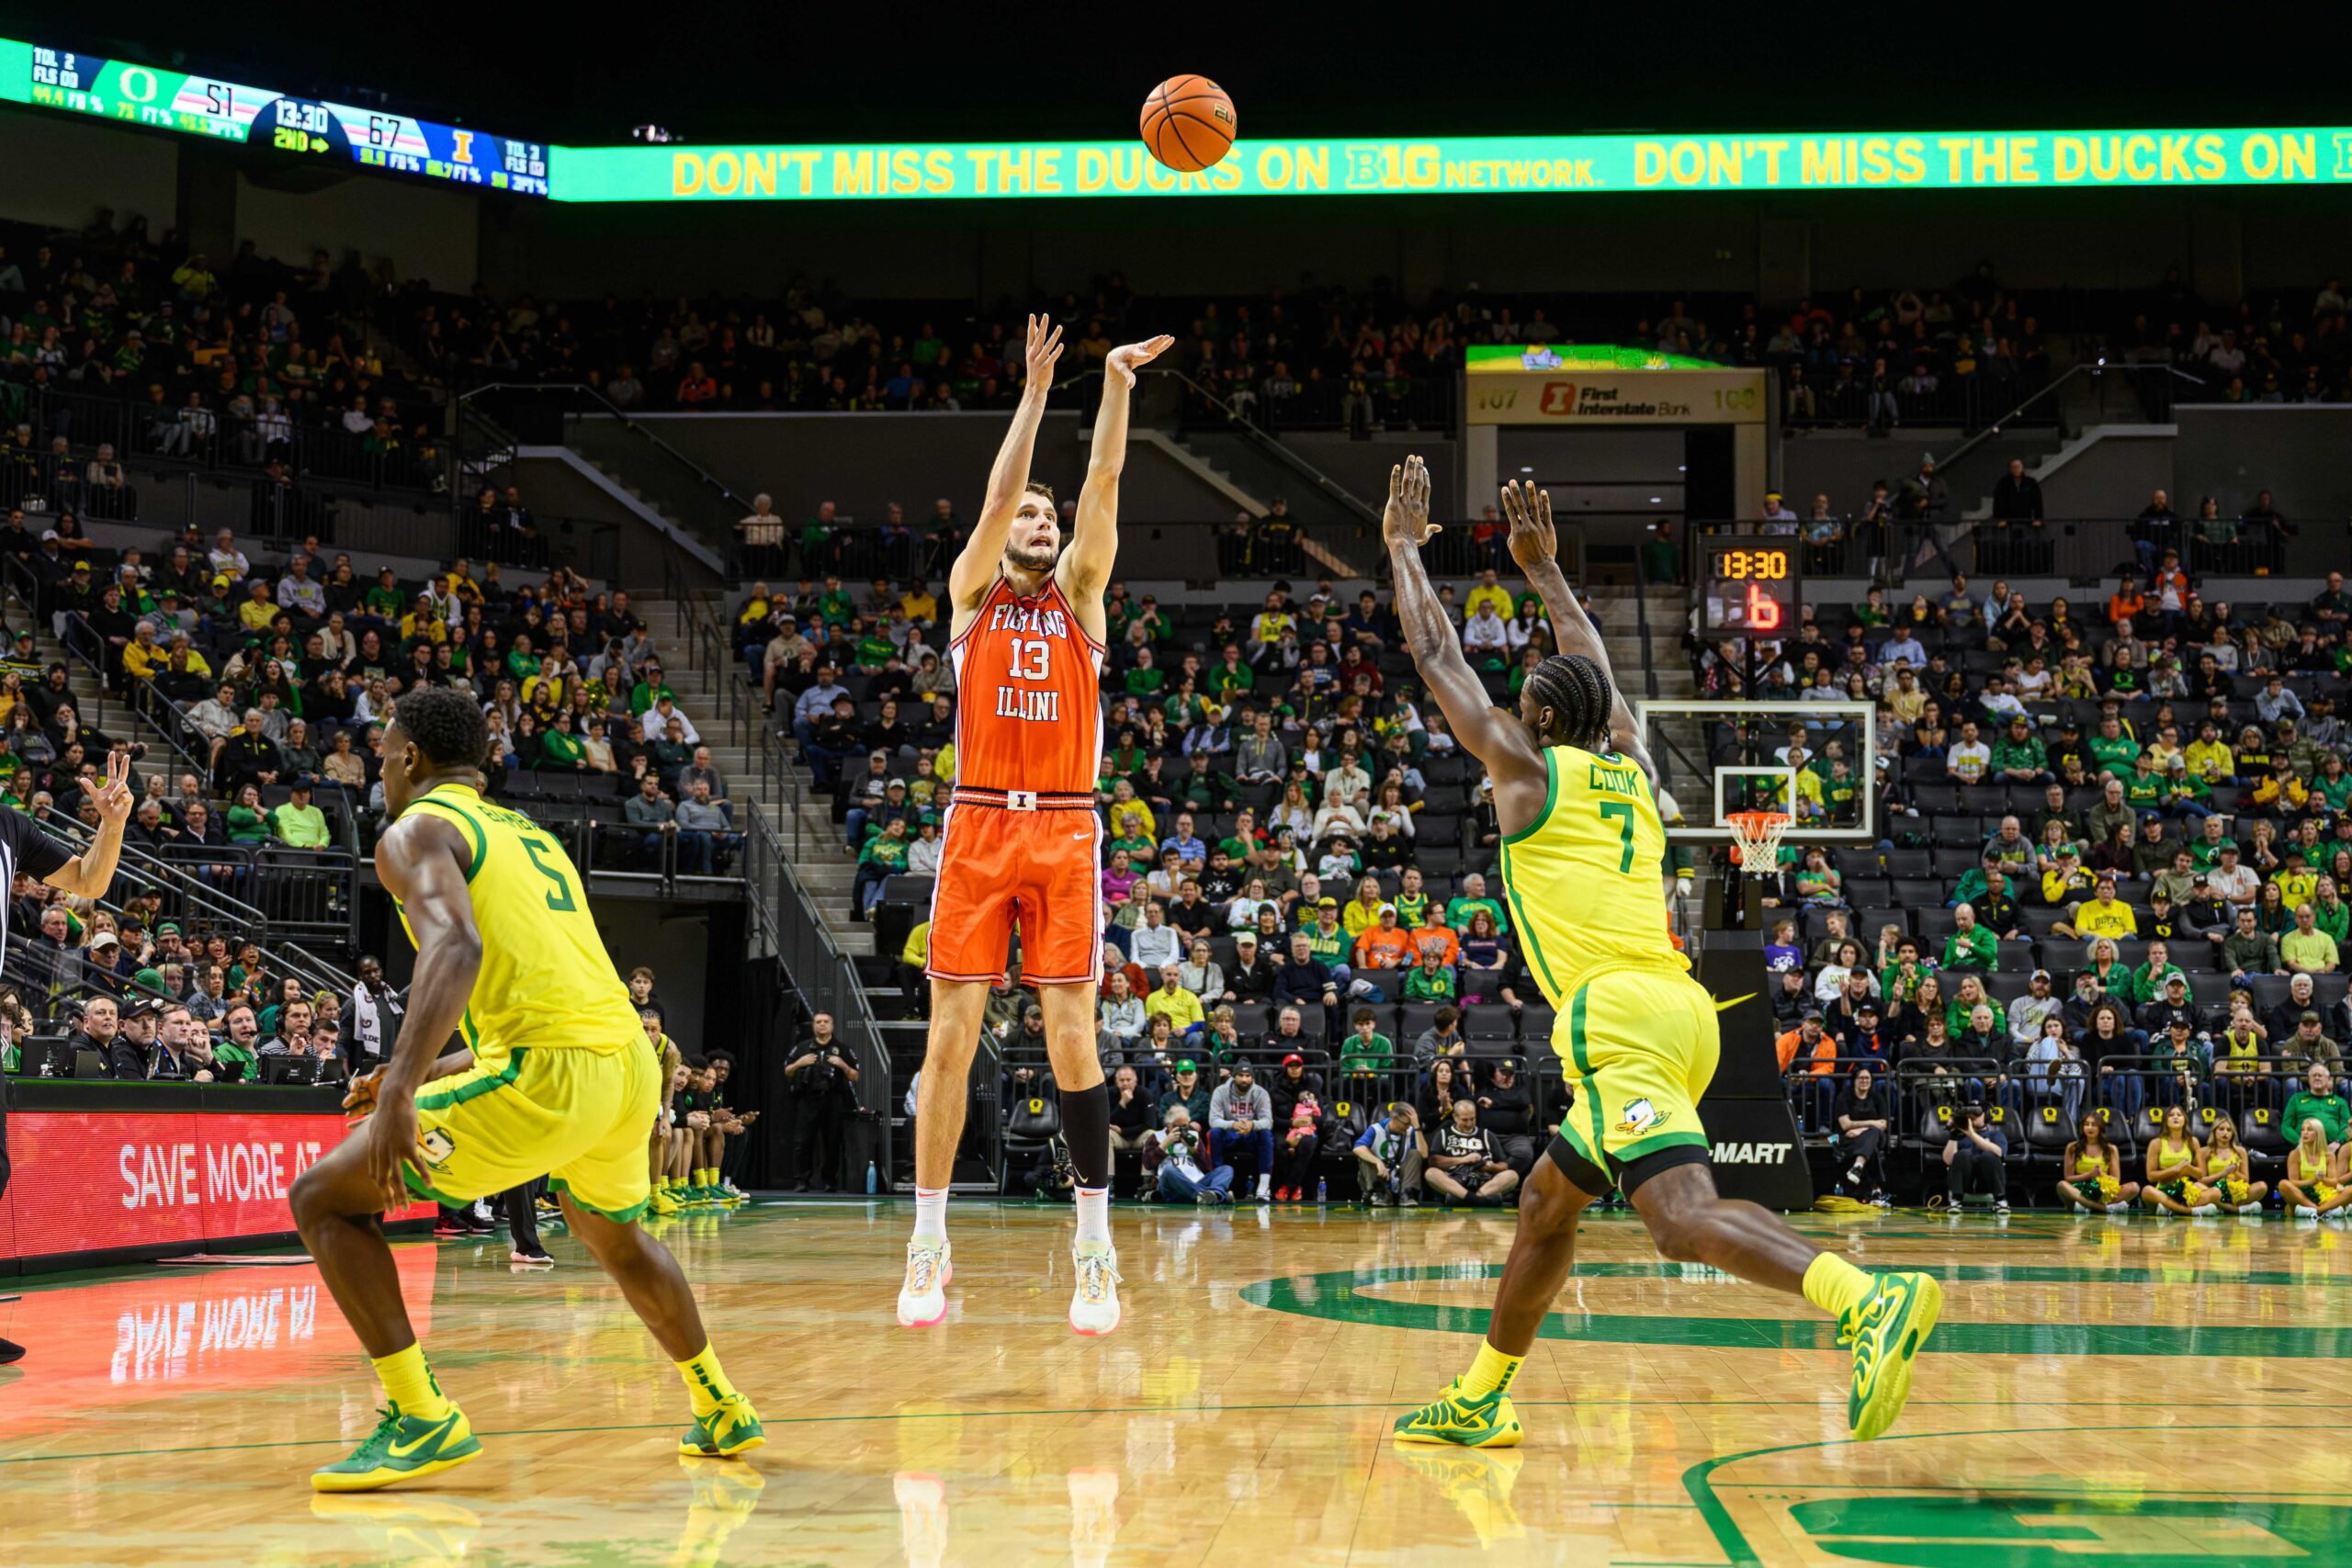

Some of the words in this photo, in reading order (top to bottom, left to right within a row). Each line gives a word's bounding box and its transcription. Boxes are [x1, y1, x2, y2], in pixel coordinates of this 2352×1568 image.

[119, 67, 157, 103] O
[207, 84, 234, 117] 51
[276, 99, 328, 133] 13:30
[369, 116, 401, 148] 67
[274, 127, 308, 152] 2ND
[452, 129, 473, 164] I
[673, 150, 822, 196] DON'T
[832, 149, 956, 194] MISS
[967, 149, 1062, 193] THE
[1257, 145, 1329, 190] ON
[1634, 141, 1789, 186] DON'T
[1802, 139, 1926, 183] MISS
[1939, 137, 2038, 182] THE
[2053, 135, 2225, 181] DUCKS
[2241, 133, 2316, 180] ON
[1477, 389, 1518, 410] 107
[1577, 402, 1656, 415] Interstate
[1657, 401, 1690, 416] Bank
[1580, 387, 1617, 401] First
[1723, 552, 1787, 580] 13:30
[1009, 637, 1050, 681] 13
[996, 686, 1058, 722] ILLINI
[1589, 763, 1639, 797] COOK
[1600, 801, 1634, 874] 7
[519, 836, 577, 912] 5
[1229, 1101, 1254, 1115] USA
[119, 1144, 200, 1210] SAVE
[206, 1142, 288, 1203] MORE
